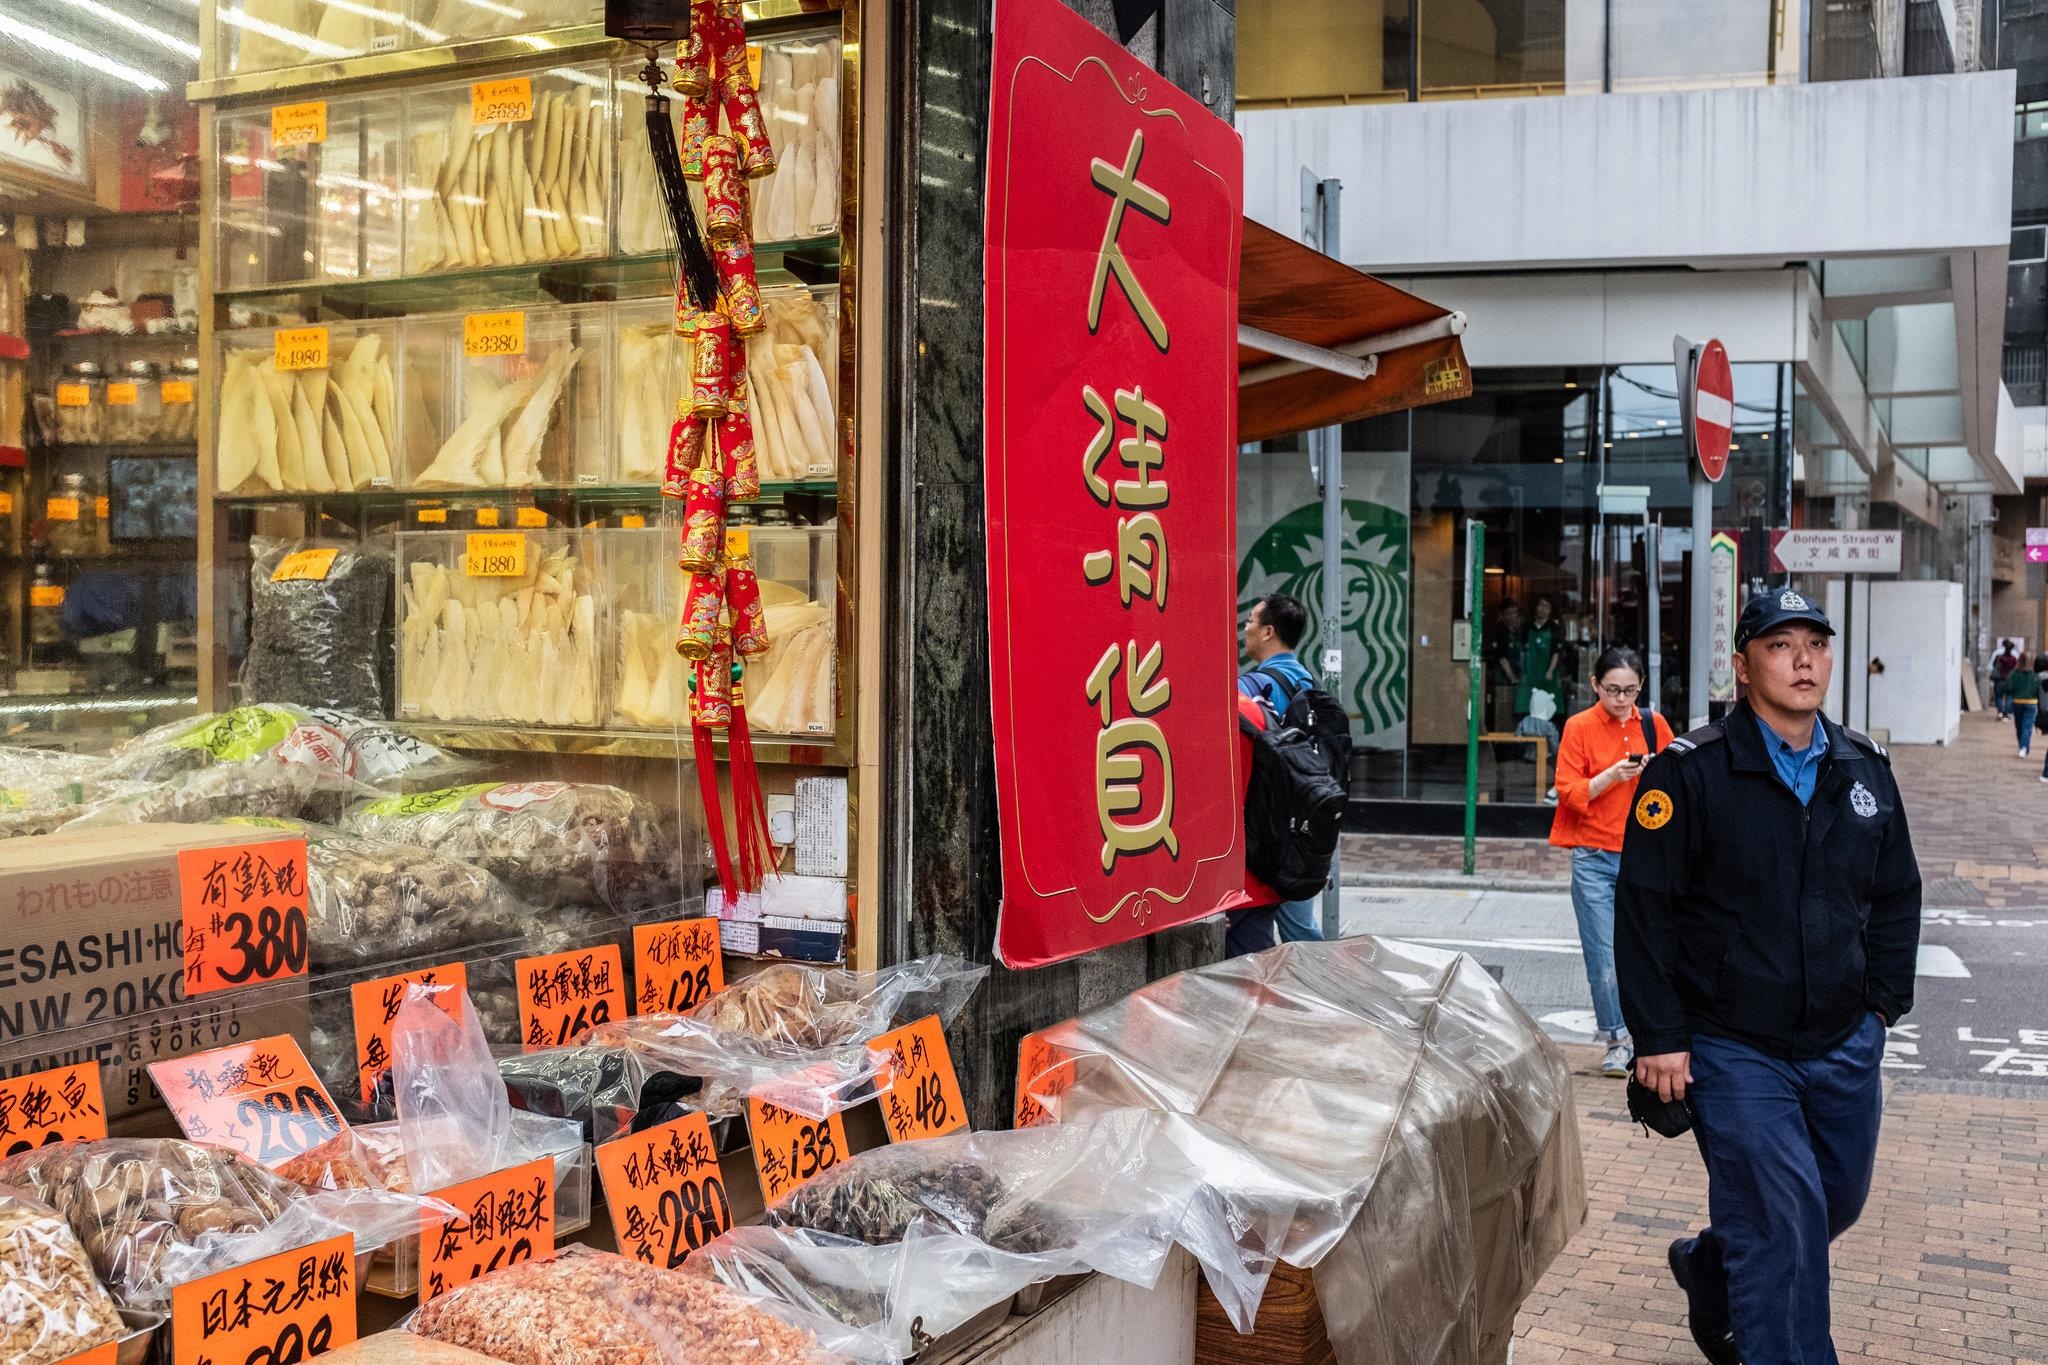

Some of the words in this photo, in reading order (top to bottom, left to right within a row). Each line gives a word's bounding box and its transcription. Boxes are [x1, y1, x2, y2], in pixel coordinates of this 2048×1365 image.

[1085, 128, 1178, 873] 大清貨
[1793, 534, 1837, 544] Bonham
[1843, 534, 1880, 544] Strand
[1884, 534, 1896, 544] W
[1808, 547, 1880, 559] 文咸西街
[16, 867, 174, 918] われもの注意
